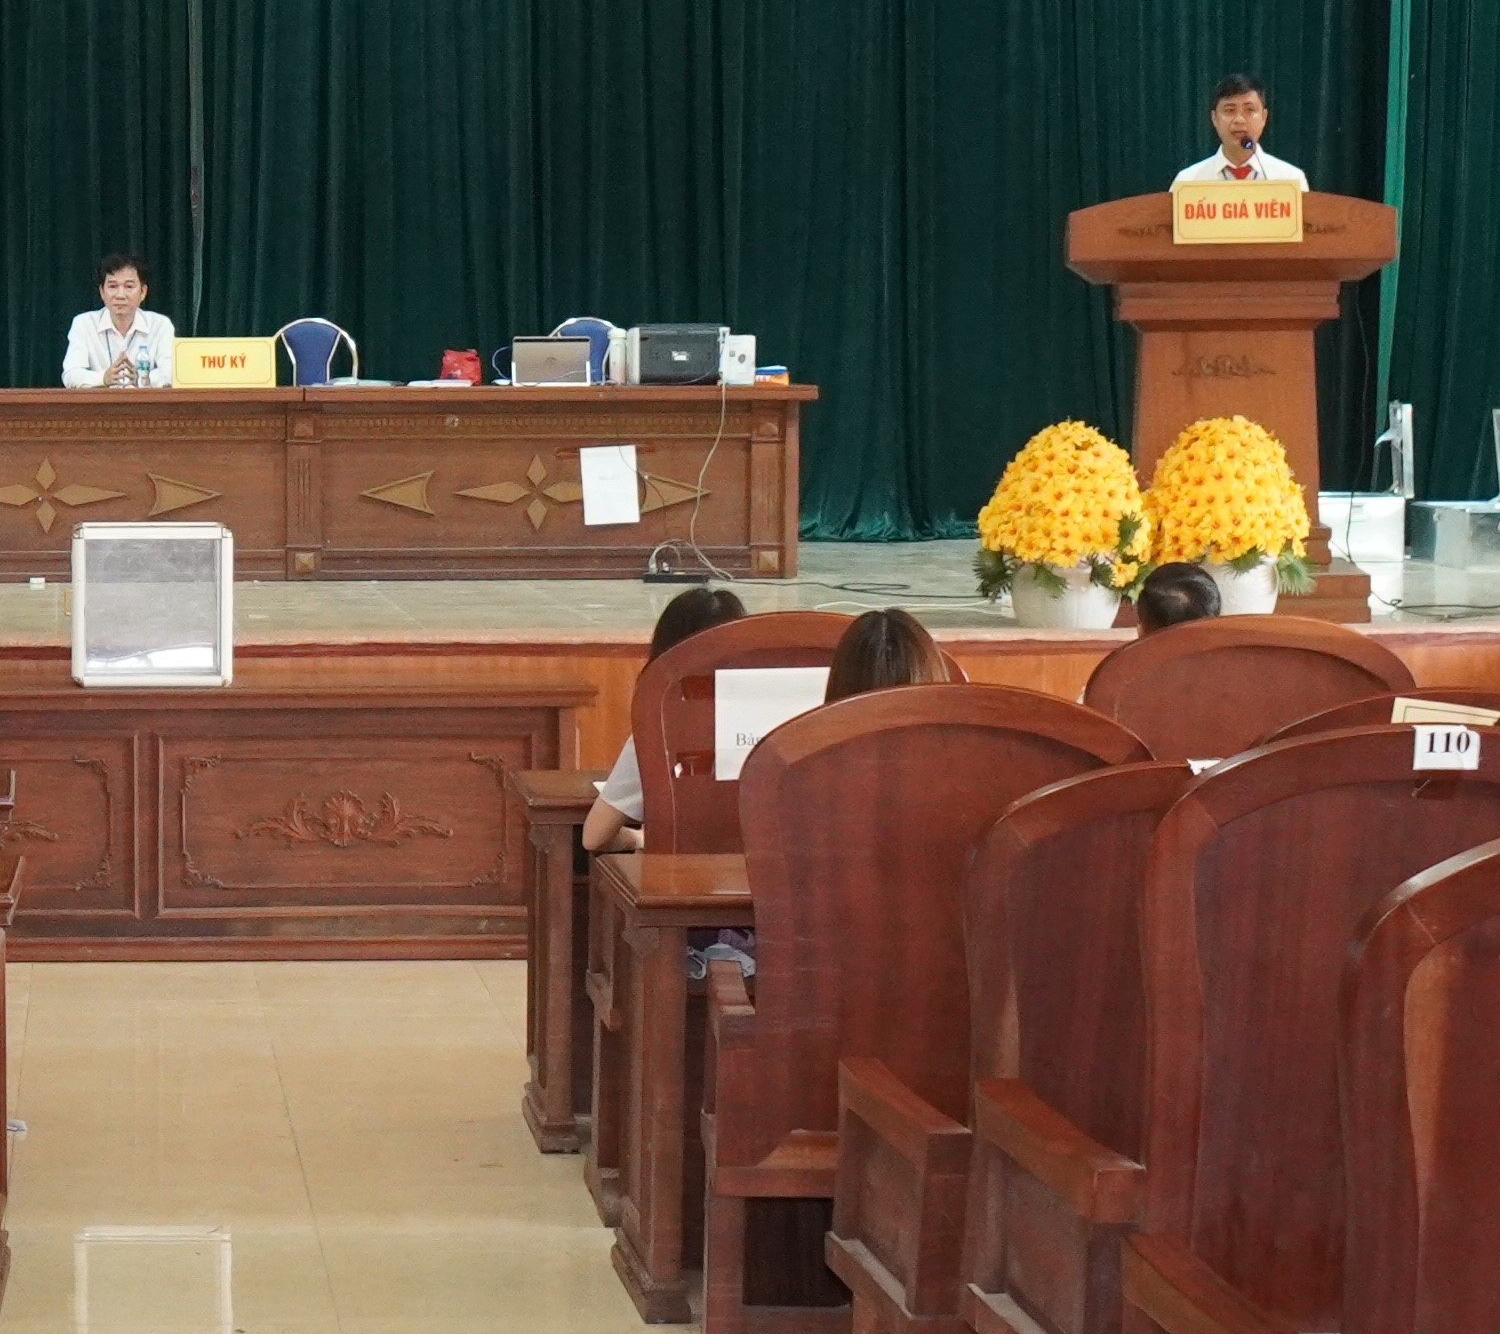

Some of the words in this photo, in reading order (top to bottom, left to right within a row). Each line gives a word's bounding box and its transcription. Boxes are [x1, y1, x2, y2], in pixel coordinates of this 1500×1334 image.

[1185, 197, 1216, 219] ĐẤU
[1222, 198, 1249, 219] GIÁ
[1254, 199, 1291, 218] VIÊN
[200, 355, 226, 368] THƯ
[230, 353, 246, 368] KÝ
[1426, 731, 1471, 754] 110
